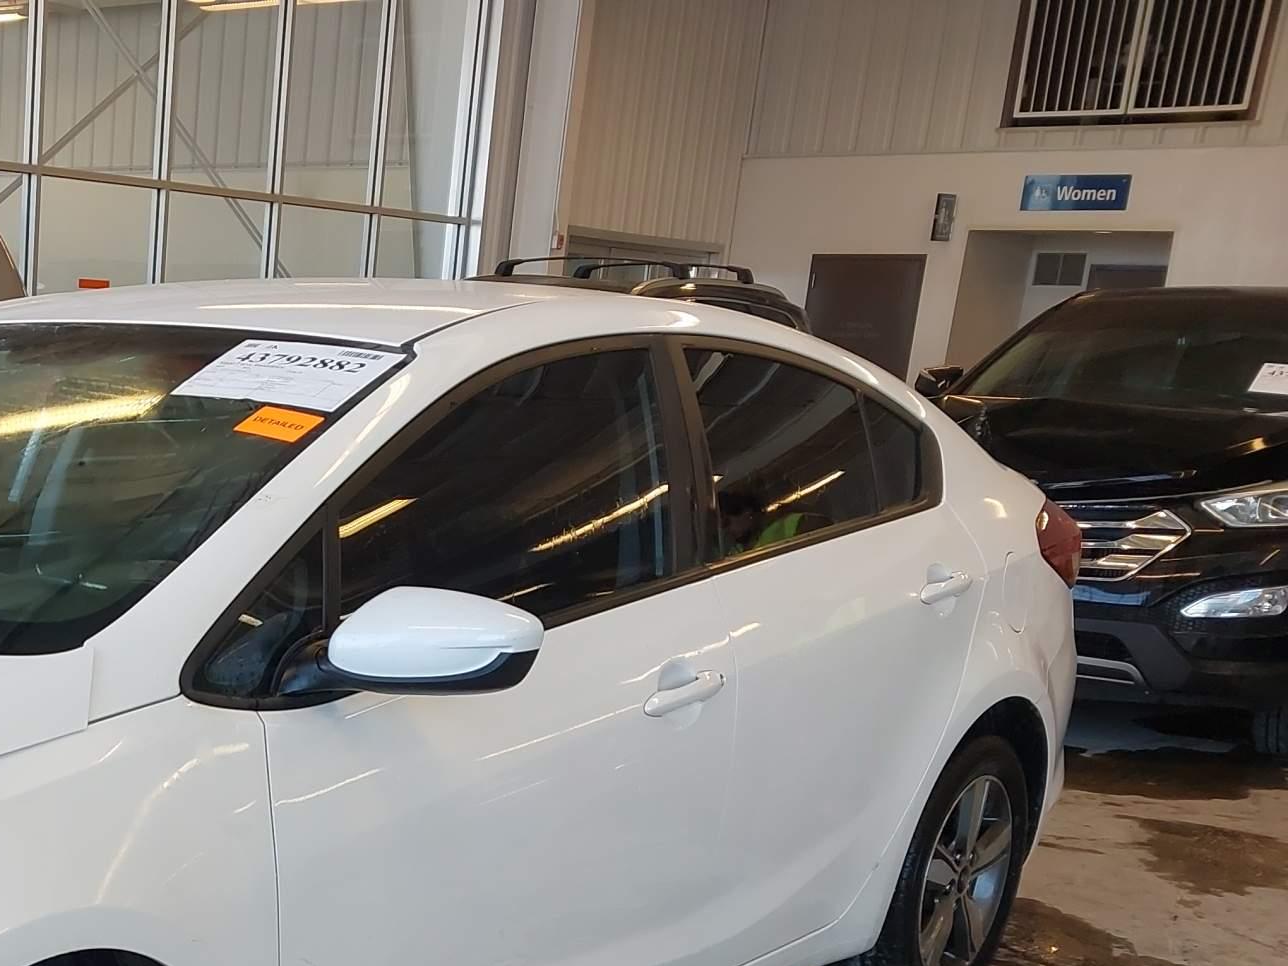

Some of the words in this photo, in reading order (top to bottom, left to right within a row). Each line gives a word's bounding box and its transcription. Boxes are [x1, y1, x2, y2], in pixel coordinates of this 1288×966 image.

[1056, 185, 1117, 201] Women
[236, 350, 367, 374] 43792882
[252, 415, 305, 431] DETAILED
